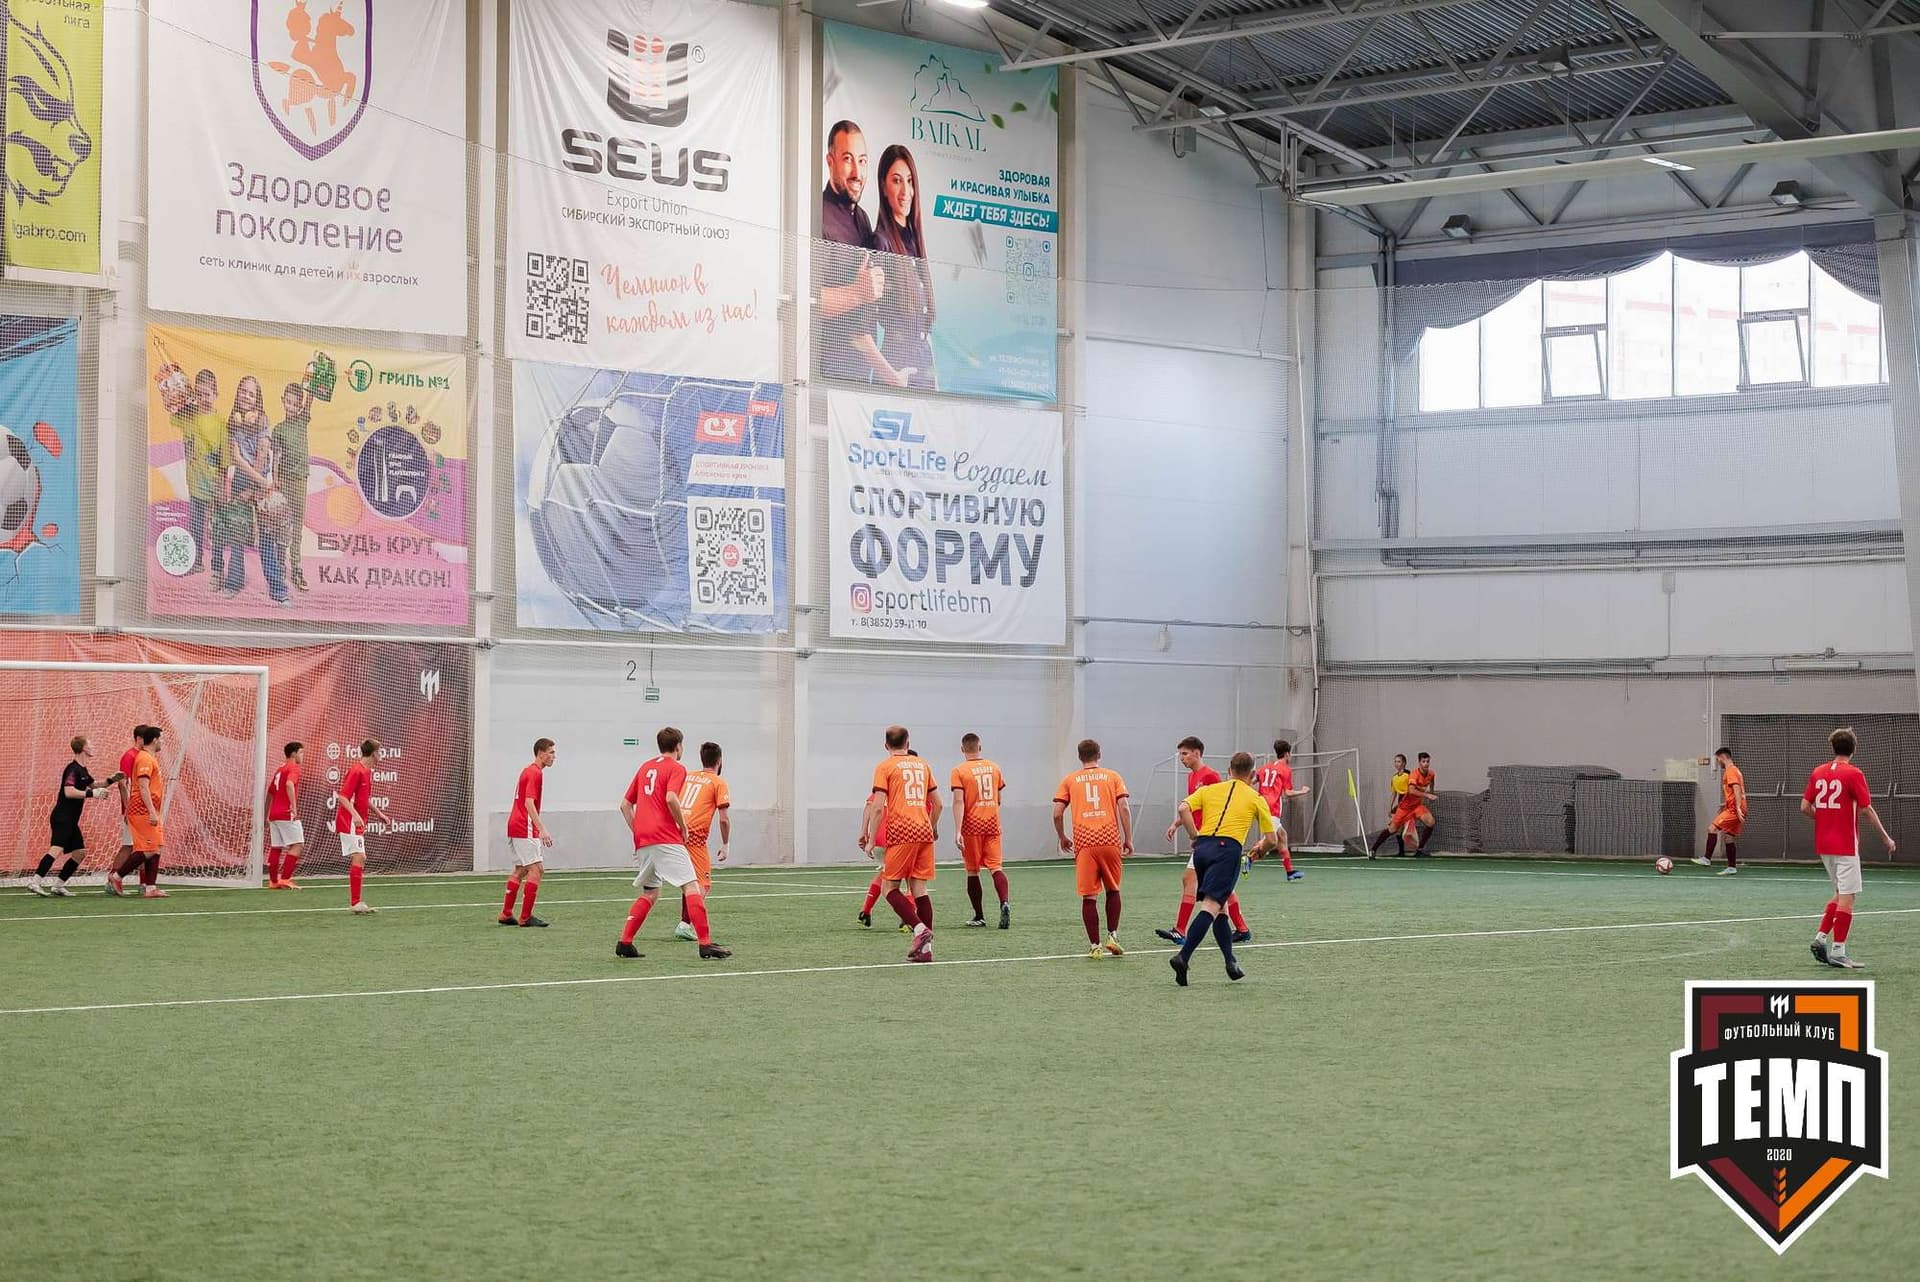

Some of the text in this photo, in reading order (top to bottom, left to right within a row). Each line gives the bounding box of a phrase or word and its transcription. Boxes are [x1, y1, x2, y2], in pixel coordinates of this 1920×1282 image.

[26, 0, 91, 12] ольная
[64, 15, 90, 29] лига
[911, 116, 987, 152] BAIKAL
[561, 128, 731, 192] SEUS
[227, 161, 391, 213] Здоровое
[950, 179, 1050, 204] И КРАСИВАЯ УЛЫБКА
[999, 169, 1050, 187] ЗДОРОВАЯ
[607, 190, 688, 216] Export Union
[942, 199, 1050, 228] ЖДЕТ ТЕБЯ ЗДЕСЬ!
[12, 219, 87, 243] igabro.com
[215, 208, 403, 253] поколение
[561, 206, 730, 240] СИБИРСКИЙ ЭКСПОРТНЫЙ СОЮЗ
[199, 255, 225, 267] сеть
[228, 258, 272, 273] клиник
[274, 264, 296, 276] для
[299, 265, 334, 279] детей
[336, 271, 344, 280] и
[362, 273, 418, 286] взрослых
[600, 262, 709, 300] Чемпион в
[606, 288, 758, 334] каждом из нас!
[379, 371, 450, 390] ГРИЛЬ №1
[869, 408, 926, 443] SL
[848, 442, 947, 471] SportLife
[953, 450, 1051, 493] Создаем
[849, 484, 1046, 527] СПОРТИВНУЮ
[317, 533, 440, 559] БУДЬ КРУТ,
[850, 523, 1045, 588] ФОРМУ
[318, 565, 451, 589] КАК ДРАКОН!
[874, 588, 991, 615] sportlifebrn
[860, 617, 893, 628] 8(3852)
[626, 659, 637, 681] 2
[345, 744, 401, 760] fctp.ru
[643, 768, 658, 795] 3
[902, 769, 925, 800] 25
[974, 774, 993, 800] 19
[1815, 779, 1842, 809] 22
[680, 782, 702, 809] 10
[1085, 782, 1100, 810] 4
[364, 818, 435, 836] mp_barnaul
